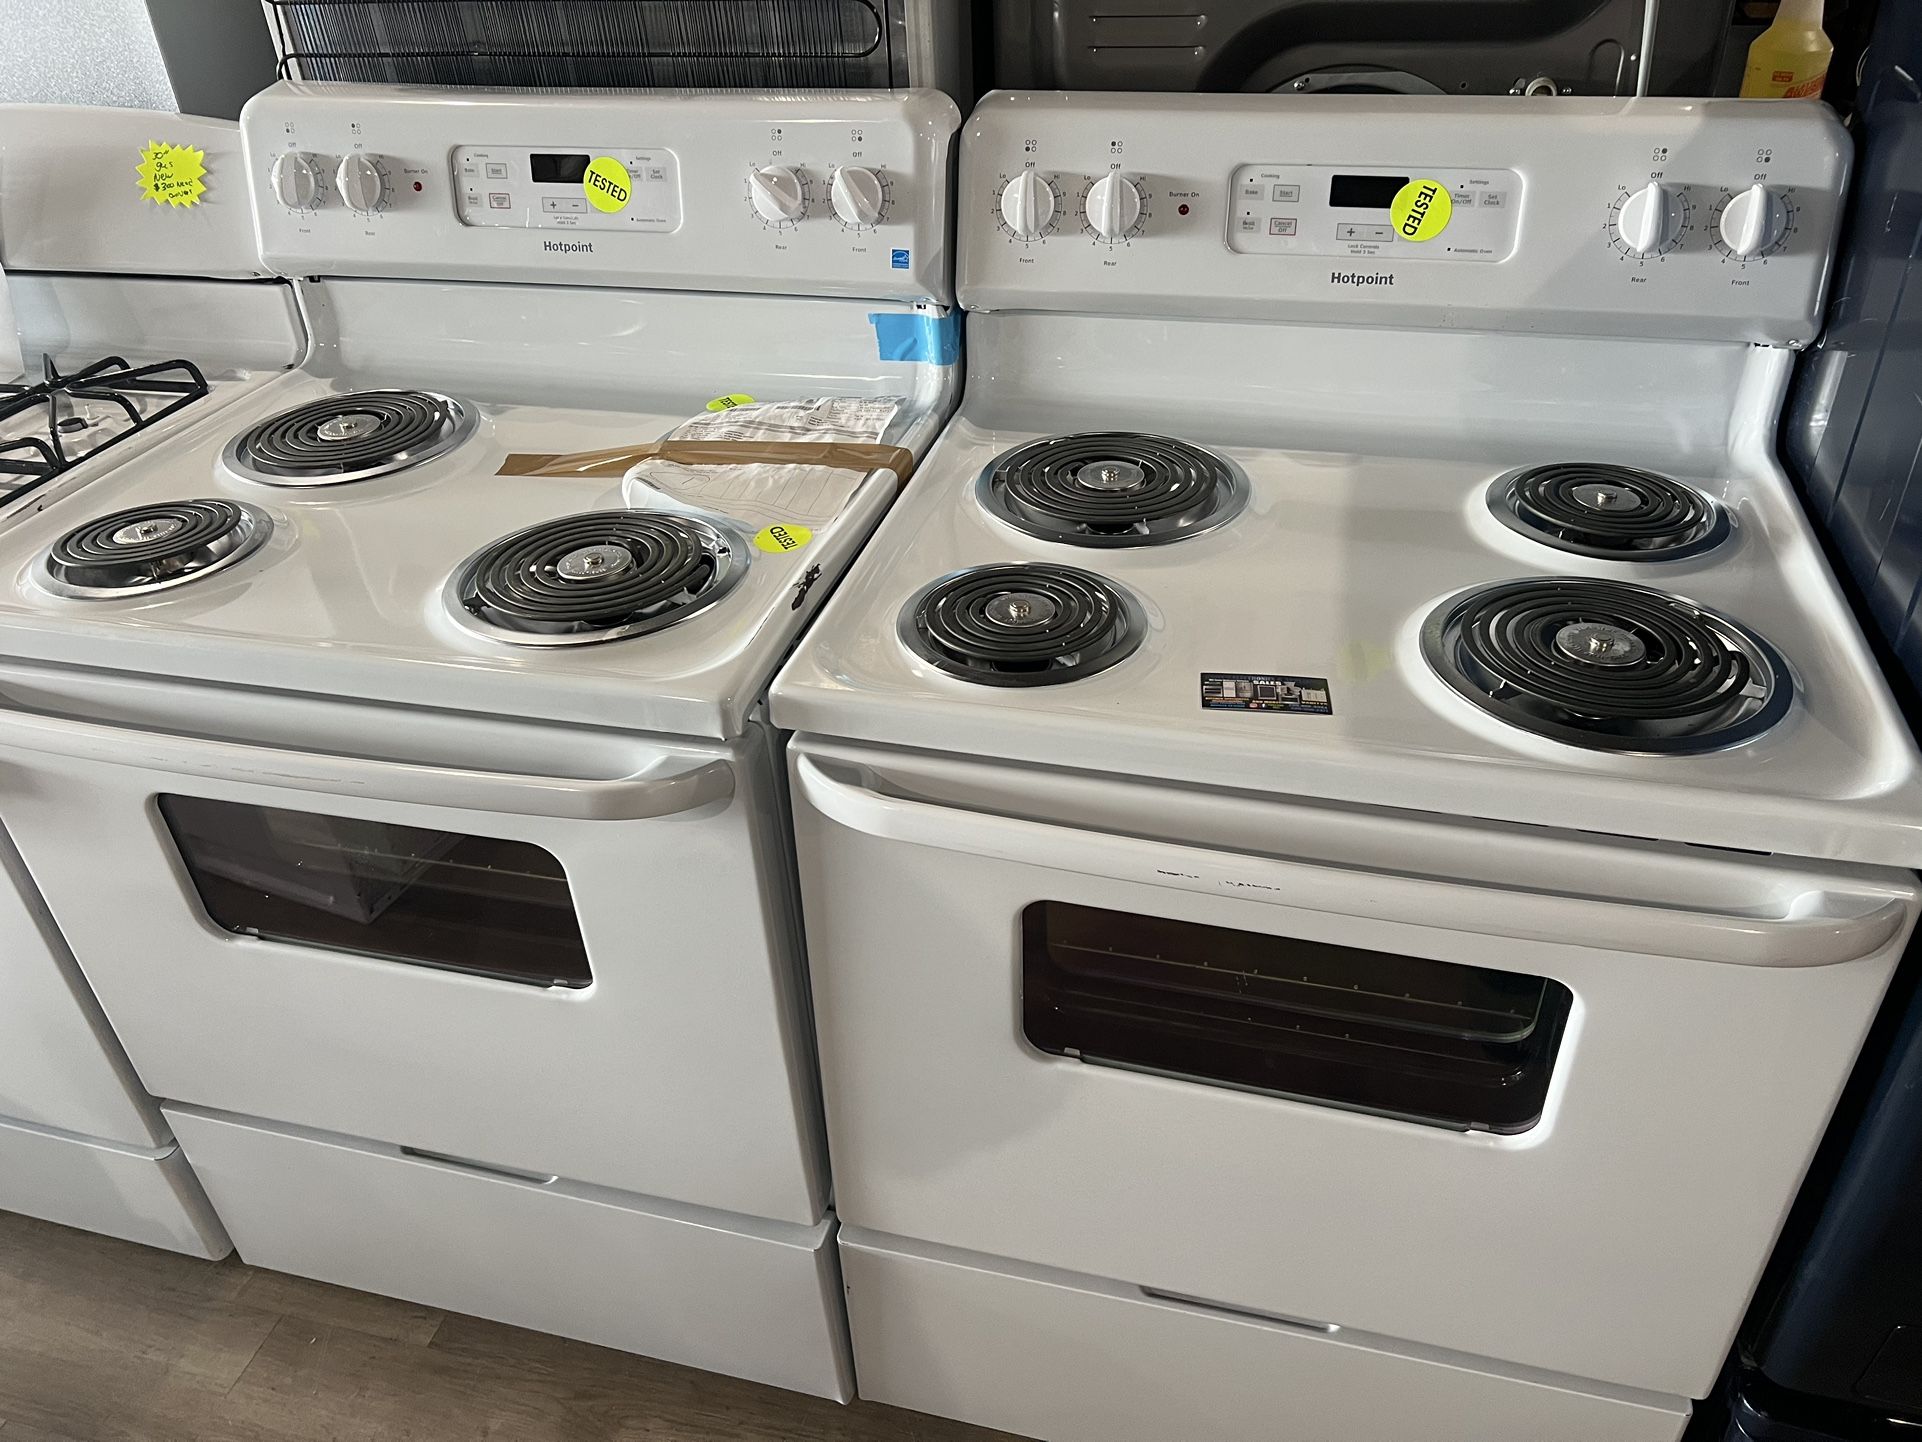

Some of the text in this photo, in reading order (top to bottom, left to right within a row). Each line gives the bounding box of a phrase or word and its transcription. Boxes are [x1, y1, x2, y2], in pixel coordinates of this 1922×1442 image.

[588, 170, 627, 202] TESTED
[1402, 185, 1438, 236] TESTED
[544, 241, 593, 253] Hotpoint
[1331, 272, 1394, 286] Hotpoint
[770, 526, 798, 550] TESTED
